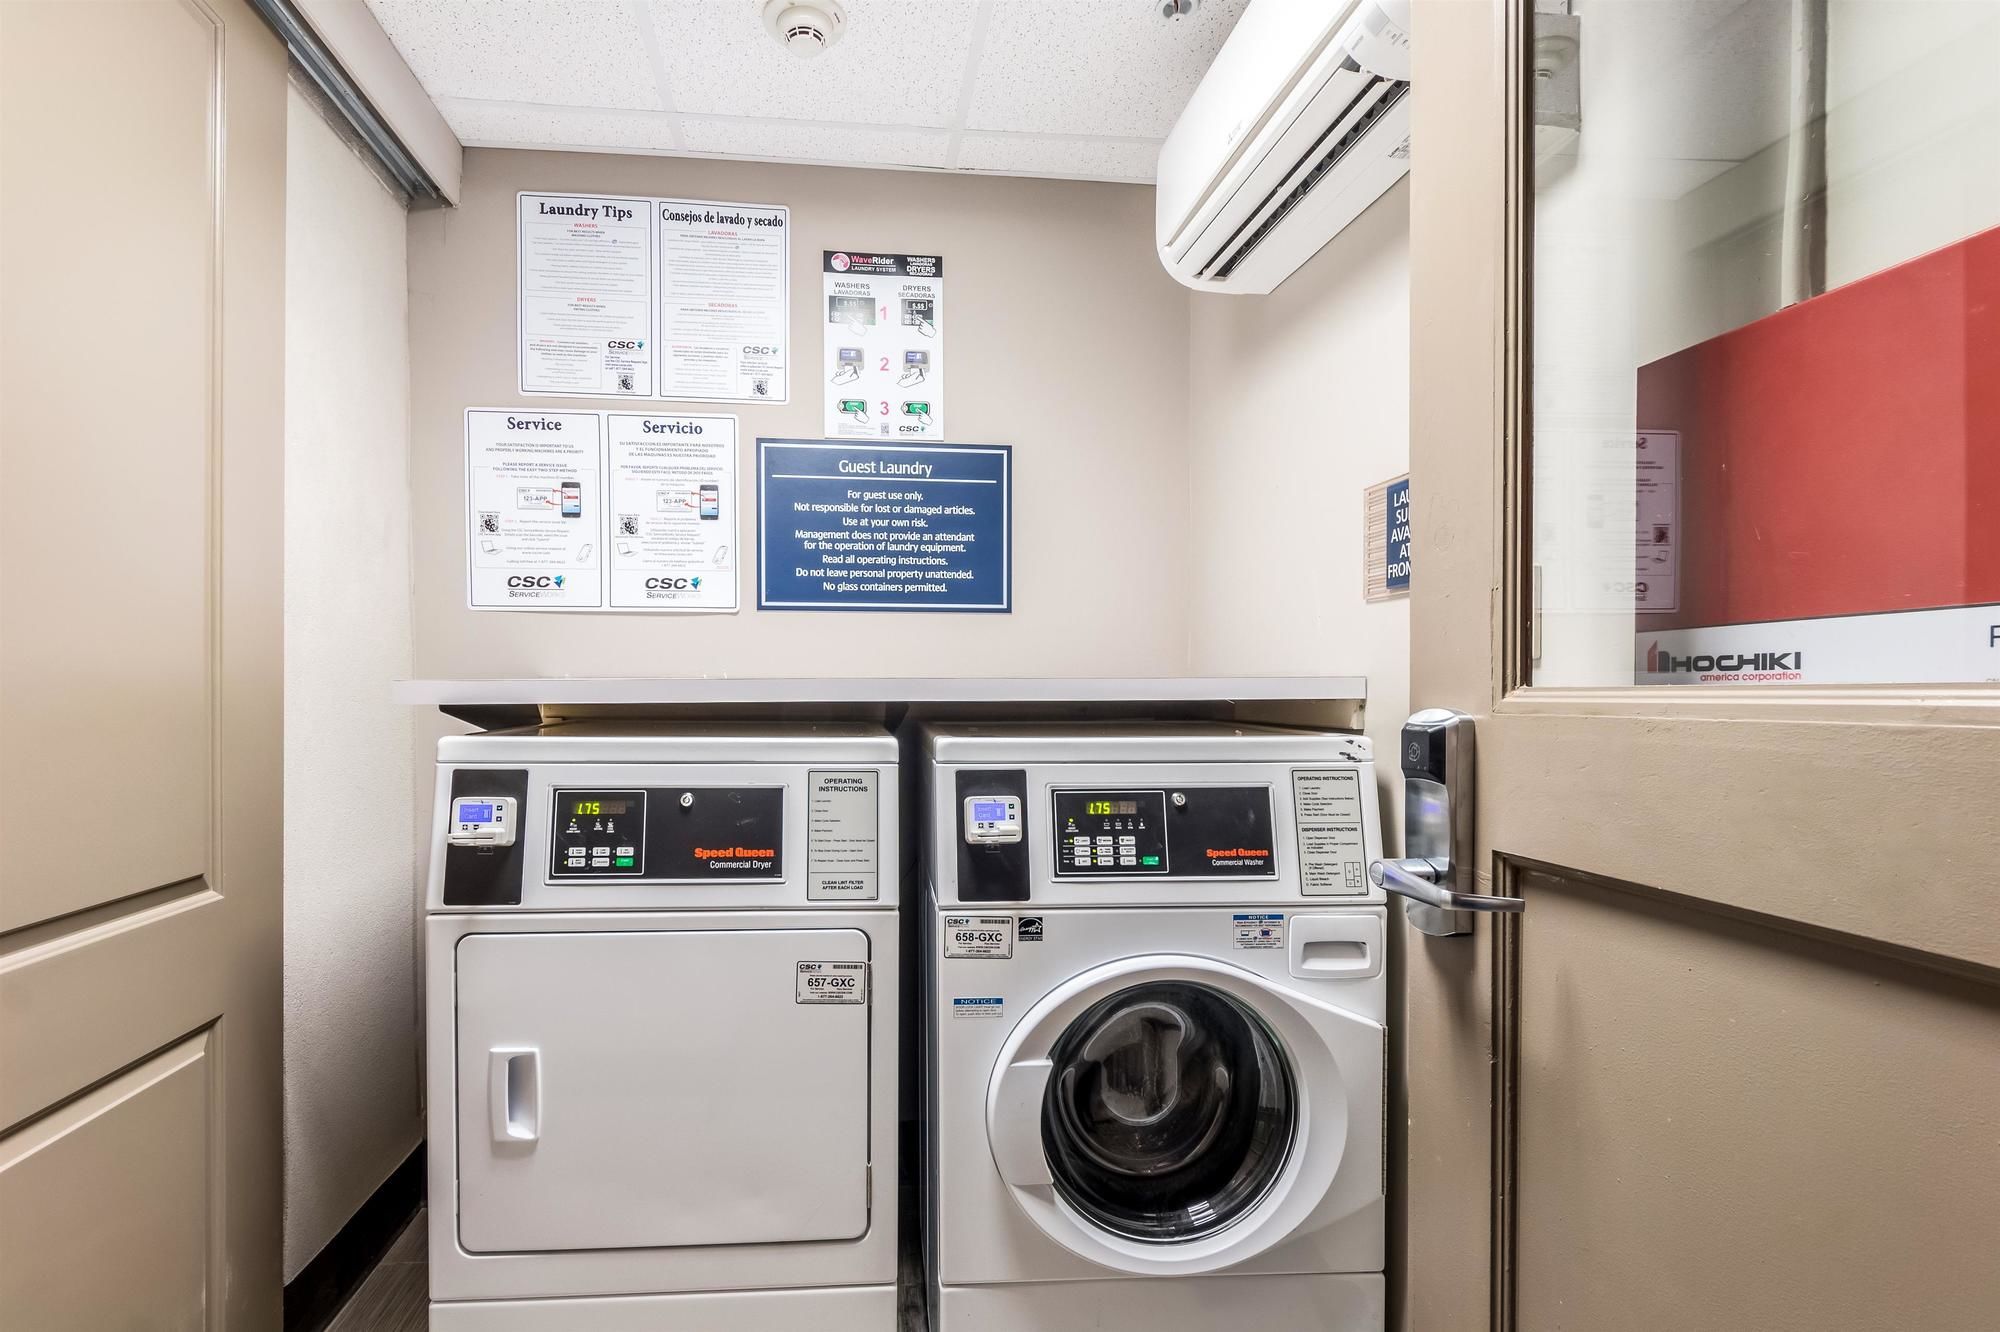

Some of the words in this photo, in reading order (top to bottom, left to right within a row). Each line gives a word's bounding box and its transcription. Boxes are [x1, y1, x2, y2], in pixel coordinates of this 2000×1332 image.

[540, 202, 598, 220] Laundry
[602, 206, 632, 221] Tips
[662, 209, 702, 225] Consejos
[704, 211, 714, 223] de
[717, 212, 745, 225] lavado
[748, 216, 752, 228] y
[754, 216, 783, 227] secado
[851, 256, 894, 264] WaveRider
[880, 307, 886, 320] 1
[608, 341, 635, 349] CSC
[743, 346, 770, 354] CSC
[880, 357, 890, 371] 2
[880, 401, 889, 415] 3
[507, 417, 562, 431] Service
[642, 421, 703, 435] Servicio
[839, 460, 876, 474] Guest
[880, 461, 932, 477] Laundry
[848, 490, 860, 499] For
[864, 491, 886, 500] guest
[905, 491, 923, 501] only.
[794, 503, 809, 511] Not
[812, 503, 858, 513] responsible
[861, 504, 873, 512] for
[875, 504, 890, 513] lost
[904, 505, 941, 516] damaged
[944, 506, 976, 515] articles.
[843, 517, 857, 526] Use
[871, 519, 889, 529] your
[912, 518, 928, 527] risk.
[795, 530, 849, 540] Management
[852, 531, 871, 540] does
[874, 532, 887, 540] not
[890, 532, 920, 542] provide
[935, 532, 974, 542] attendant
[804, 541, 816, 550] for
[819, 541, 832, 550] the
[835, 542, 874, 552] operation
[876, 542, 885, 550] of
[887, 542, 918, 553] laundry
[920, 544, 966, 554] equipment.
[823, 555, 843, 564] Read
[846, 556, 854, 564] all
[857, 556, 896, 566] operating
[899, 556, 948, 566] instructions.
[796, 568, 808, 576] Do
[810, 568, 824, 577] not
[827, 569, 848, 577] leave
[850, 569, 885, 579] personal
[887, 570, 923, 580] property
[925, 570, 974, 579] unattended.
[508, 576, 550, 588] CSC
[645, 578, 687, 590] CSC
[823, 582, 835, 591] No
[837, 582, 858, 593] glass
[860, 582, 902, 592] containers
[905, 583, 948, 593] permitted.
[1671, 652, 1801, 672] HOCHIKI
[1700, 674, 1739, 682] america
[1742, 672, 1801, 682] corporation
[694, 848, 733, 859] Speed
[736, 847, 774, 858] Queen
[1206, 849, 1237, 858] Speed
[1238, 848, 1268, 857] Queen
[710, 860, 750, 869] Commercial
[753, 861, 772, 870] Dryer
[956, 933, 1002, 942] 658-GXC
[808, 978, 855, 987] 657-GXC
